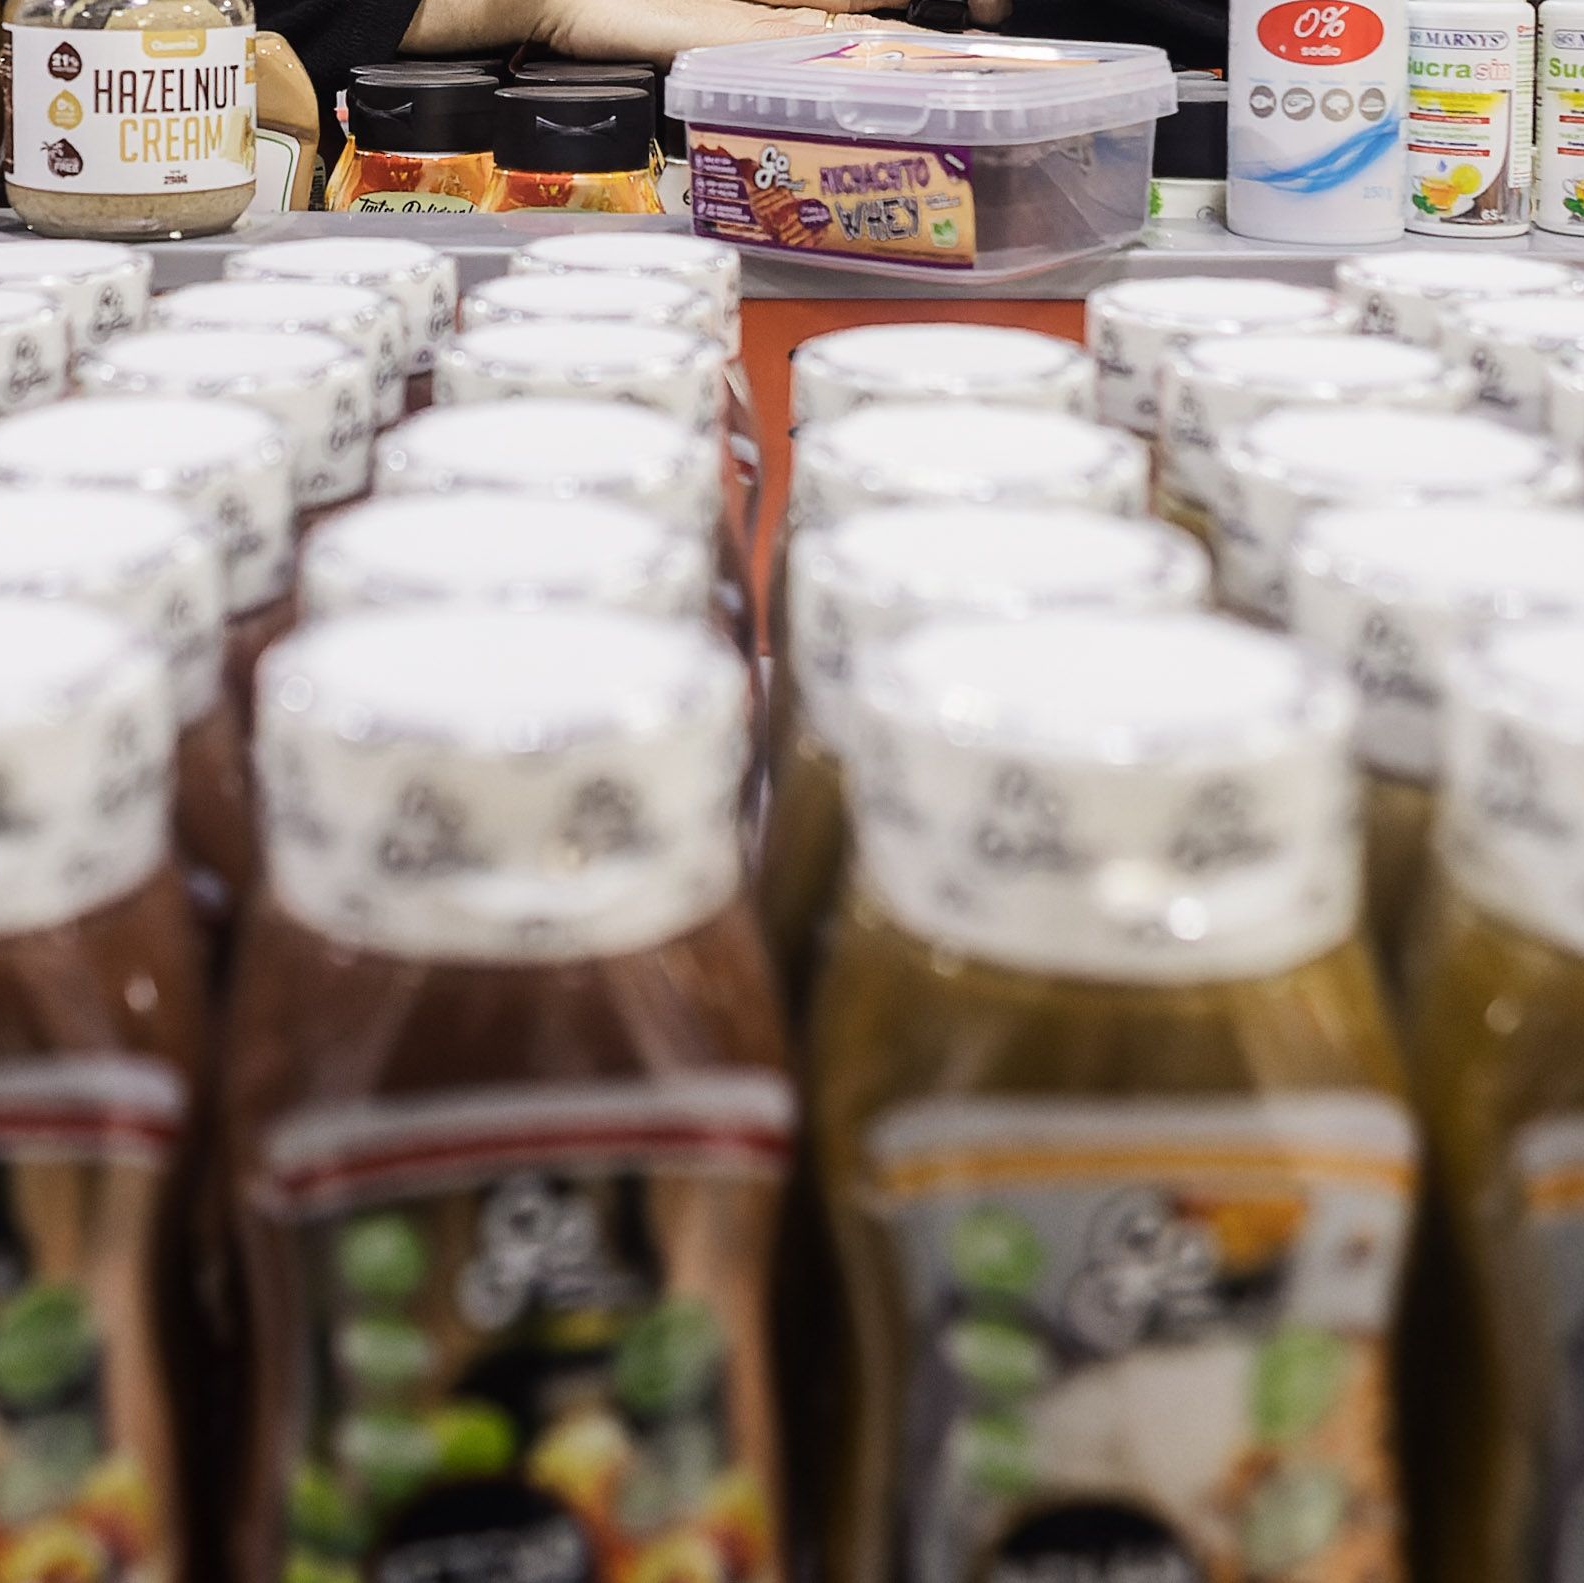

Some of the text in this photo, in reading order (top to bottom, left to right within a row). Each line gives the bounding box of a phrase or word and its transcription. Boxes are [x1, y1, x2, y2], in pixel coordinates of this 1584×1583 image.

[1293, 5, 1350, 39] 0%
[1426, 31, 1499, 48] MARNYS
[93, 65, 239, 114] HAZELNUT
[119, 114, 223, 163] CREAM
